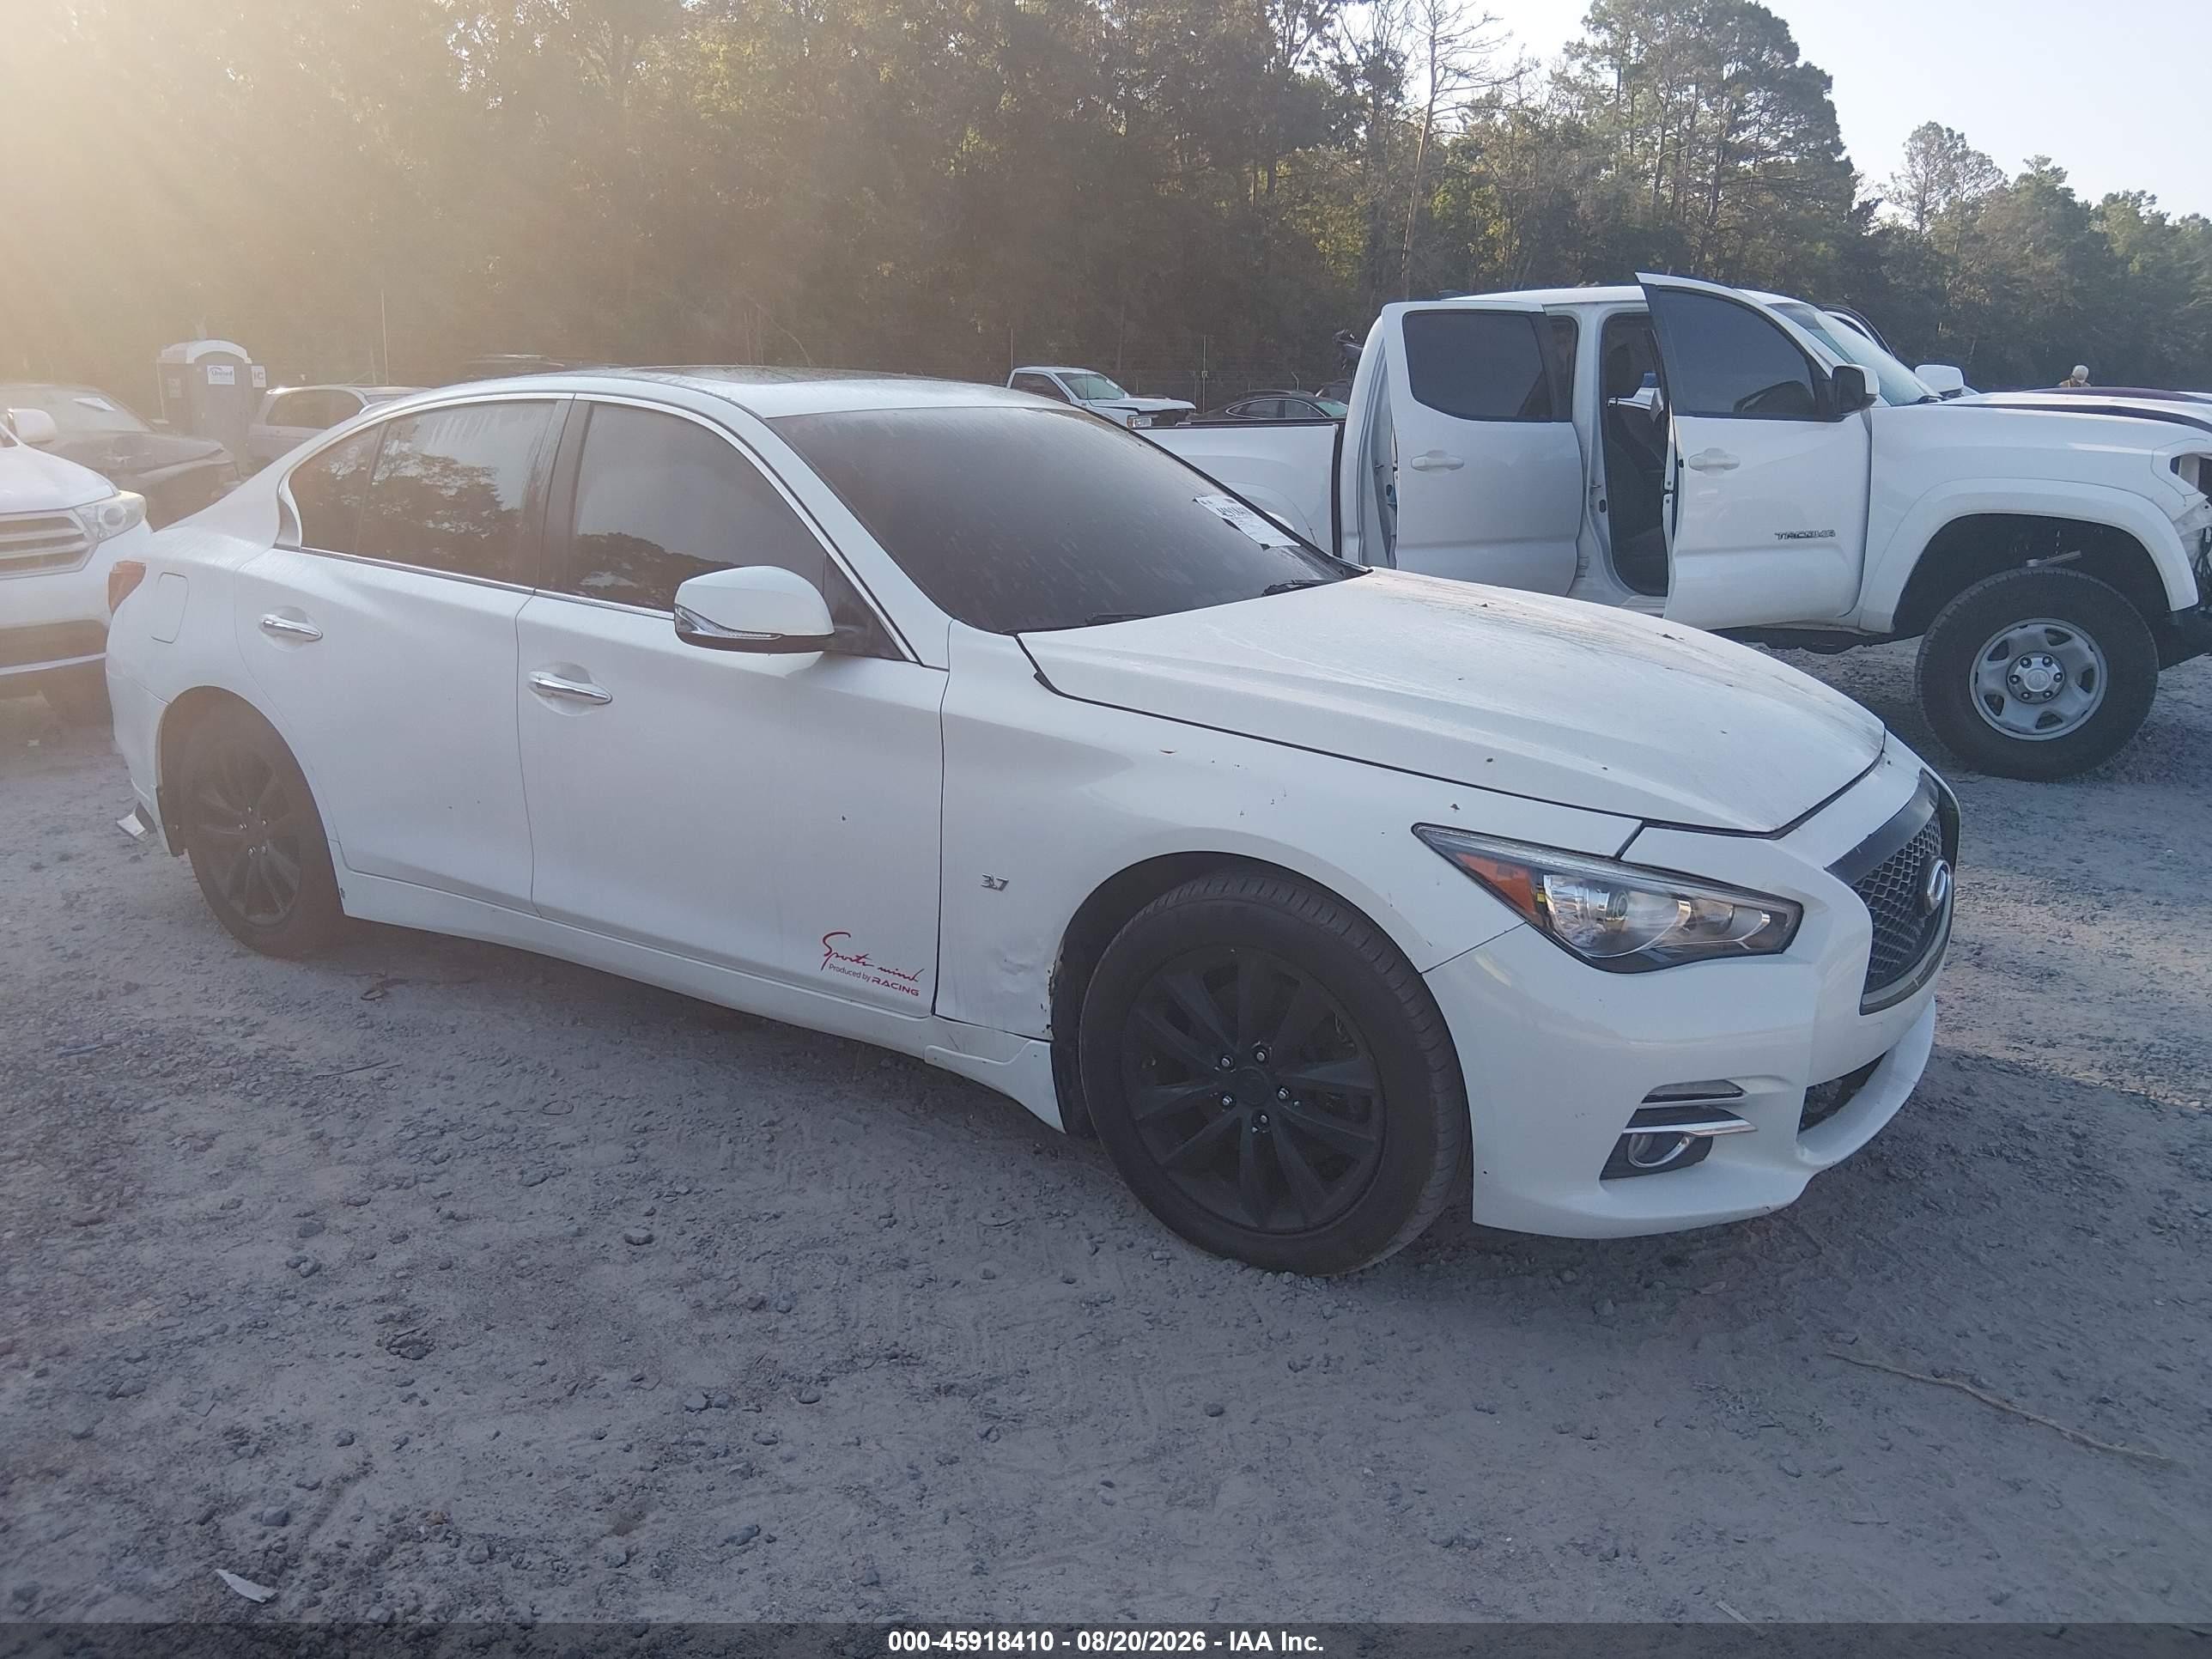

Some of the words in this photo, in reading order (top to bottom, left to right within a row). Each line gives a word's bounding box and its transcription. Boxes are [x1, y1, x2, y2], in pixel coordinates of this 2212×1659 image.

[1774, 529, 1836, 540] TACOMA
[829, 963, 861, 979] Produced
[862, 971, 872, 982] by
[871, 976, 920, 996] RACING
